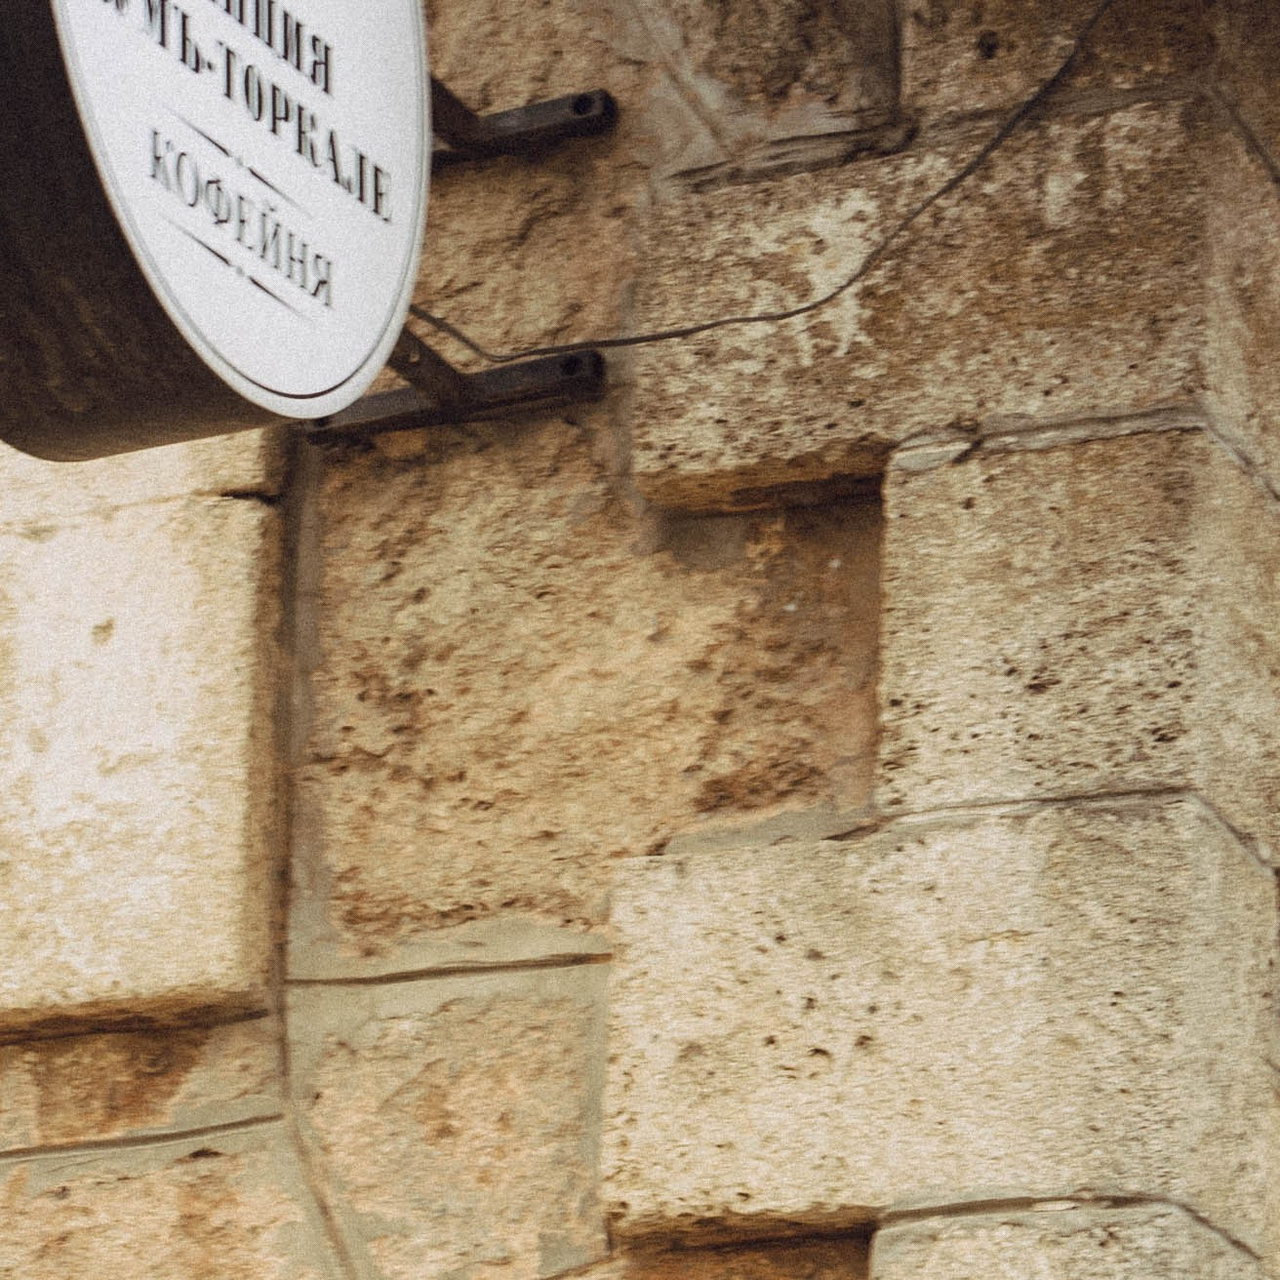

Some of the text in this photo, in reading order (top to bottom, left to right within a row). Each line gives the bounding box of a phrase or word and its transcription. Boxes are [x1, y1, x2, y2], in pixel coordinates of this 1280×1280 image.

[102, 0, 391, 224] МЪ-ТОРКАЛЕ
[207, 0, 333, 95] ЦИЯ
[151, 128, 333, 307] КОФЕЙНЯ
